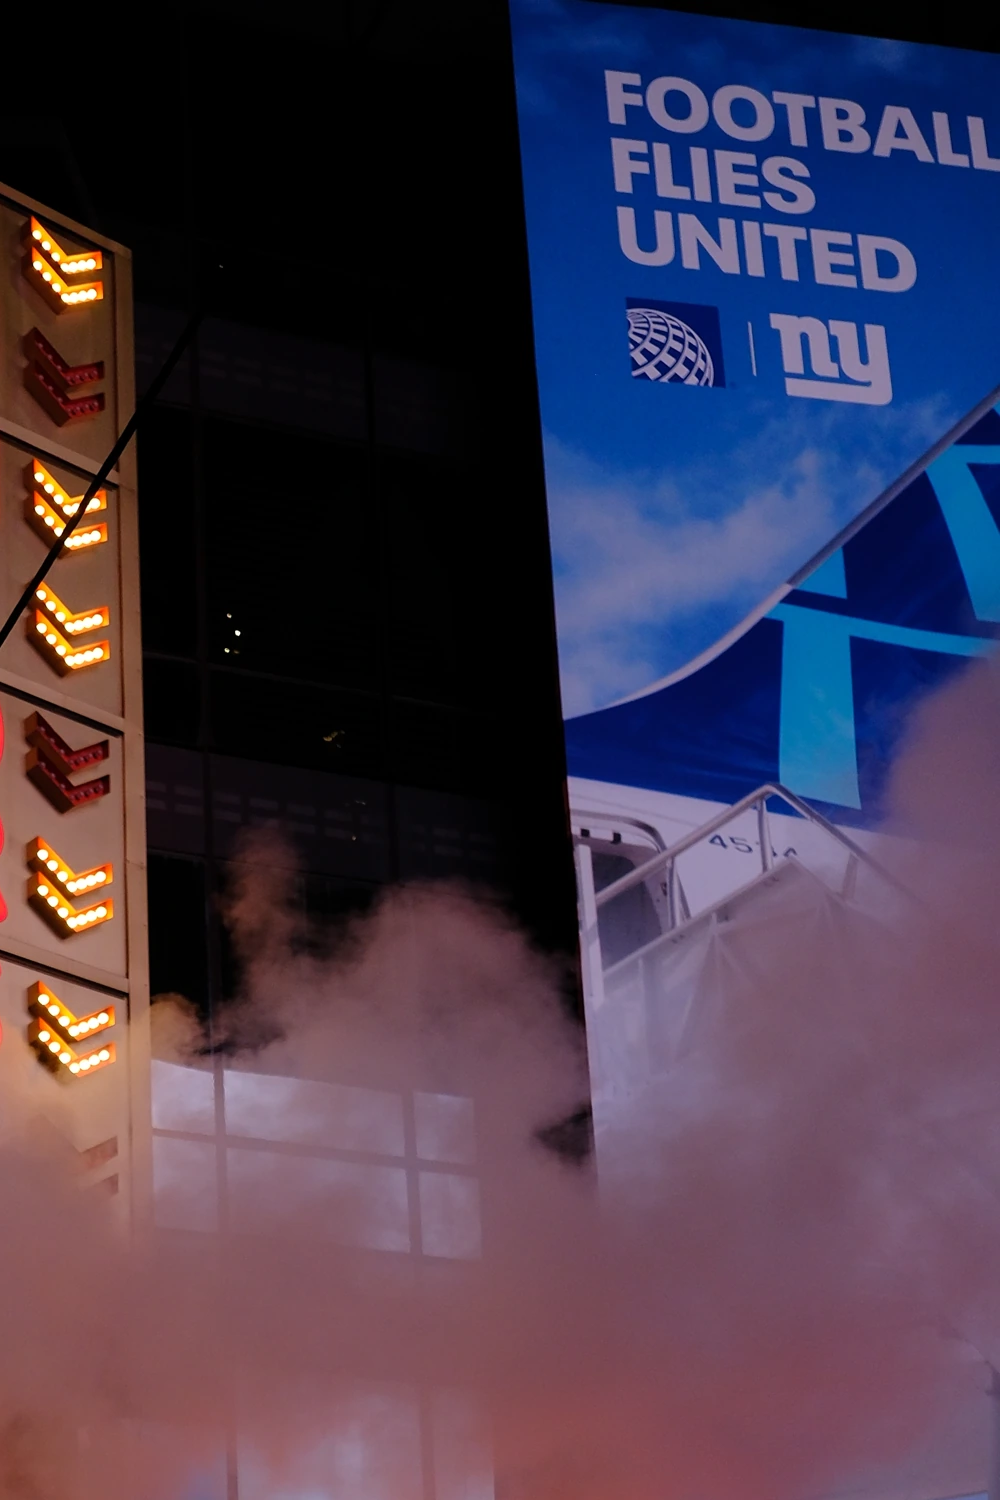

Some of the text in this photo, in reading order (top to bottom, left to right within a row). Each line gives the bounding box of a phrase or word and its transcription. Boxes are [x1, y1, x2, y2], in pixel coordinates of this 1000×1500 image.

[604, 69, 1000, 172] FOOTBALL
[610, 136, 816, 215] FLIES
[616, 205, 918, 293] UNITED
